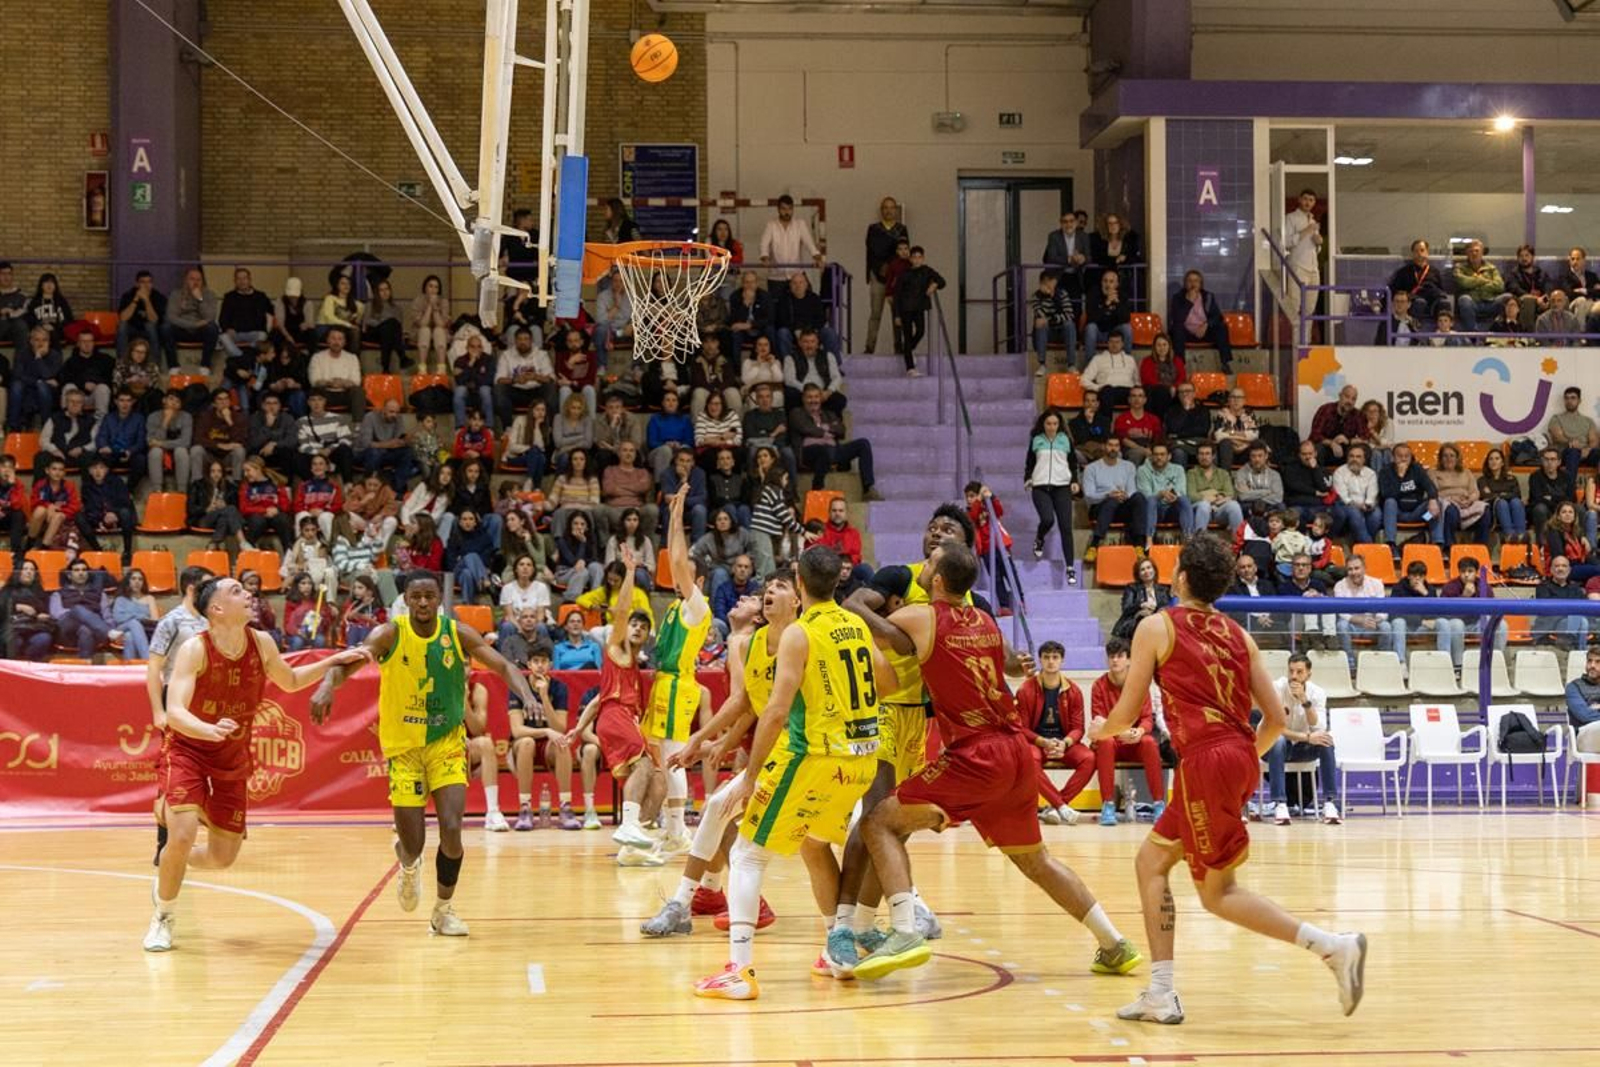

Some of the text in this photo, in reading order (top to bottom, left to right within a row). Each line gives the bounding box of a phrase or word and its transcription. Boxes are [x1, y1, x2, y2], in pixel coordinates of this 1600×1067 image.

[131, 147, 151, 173] A
[1199, 179, 1218, 205] A
[228, 667, 241, 686] 16
[838, 646, 877, 711] 13
[93, 758, 157, 772] Ayuntamie
[340, 750, 377, 764] CAJA
[128, 770, 158, 781] Jaén
